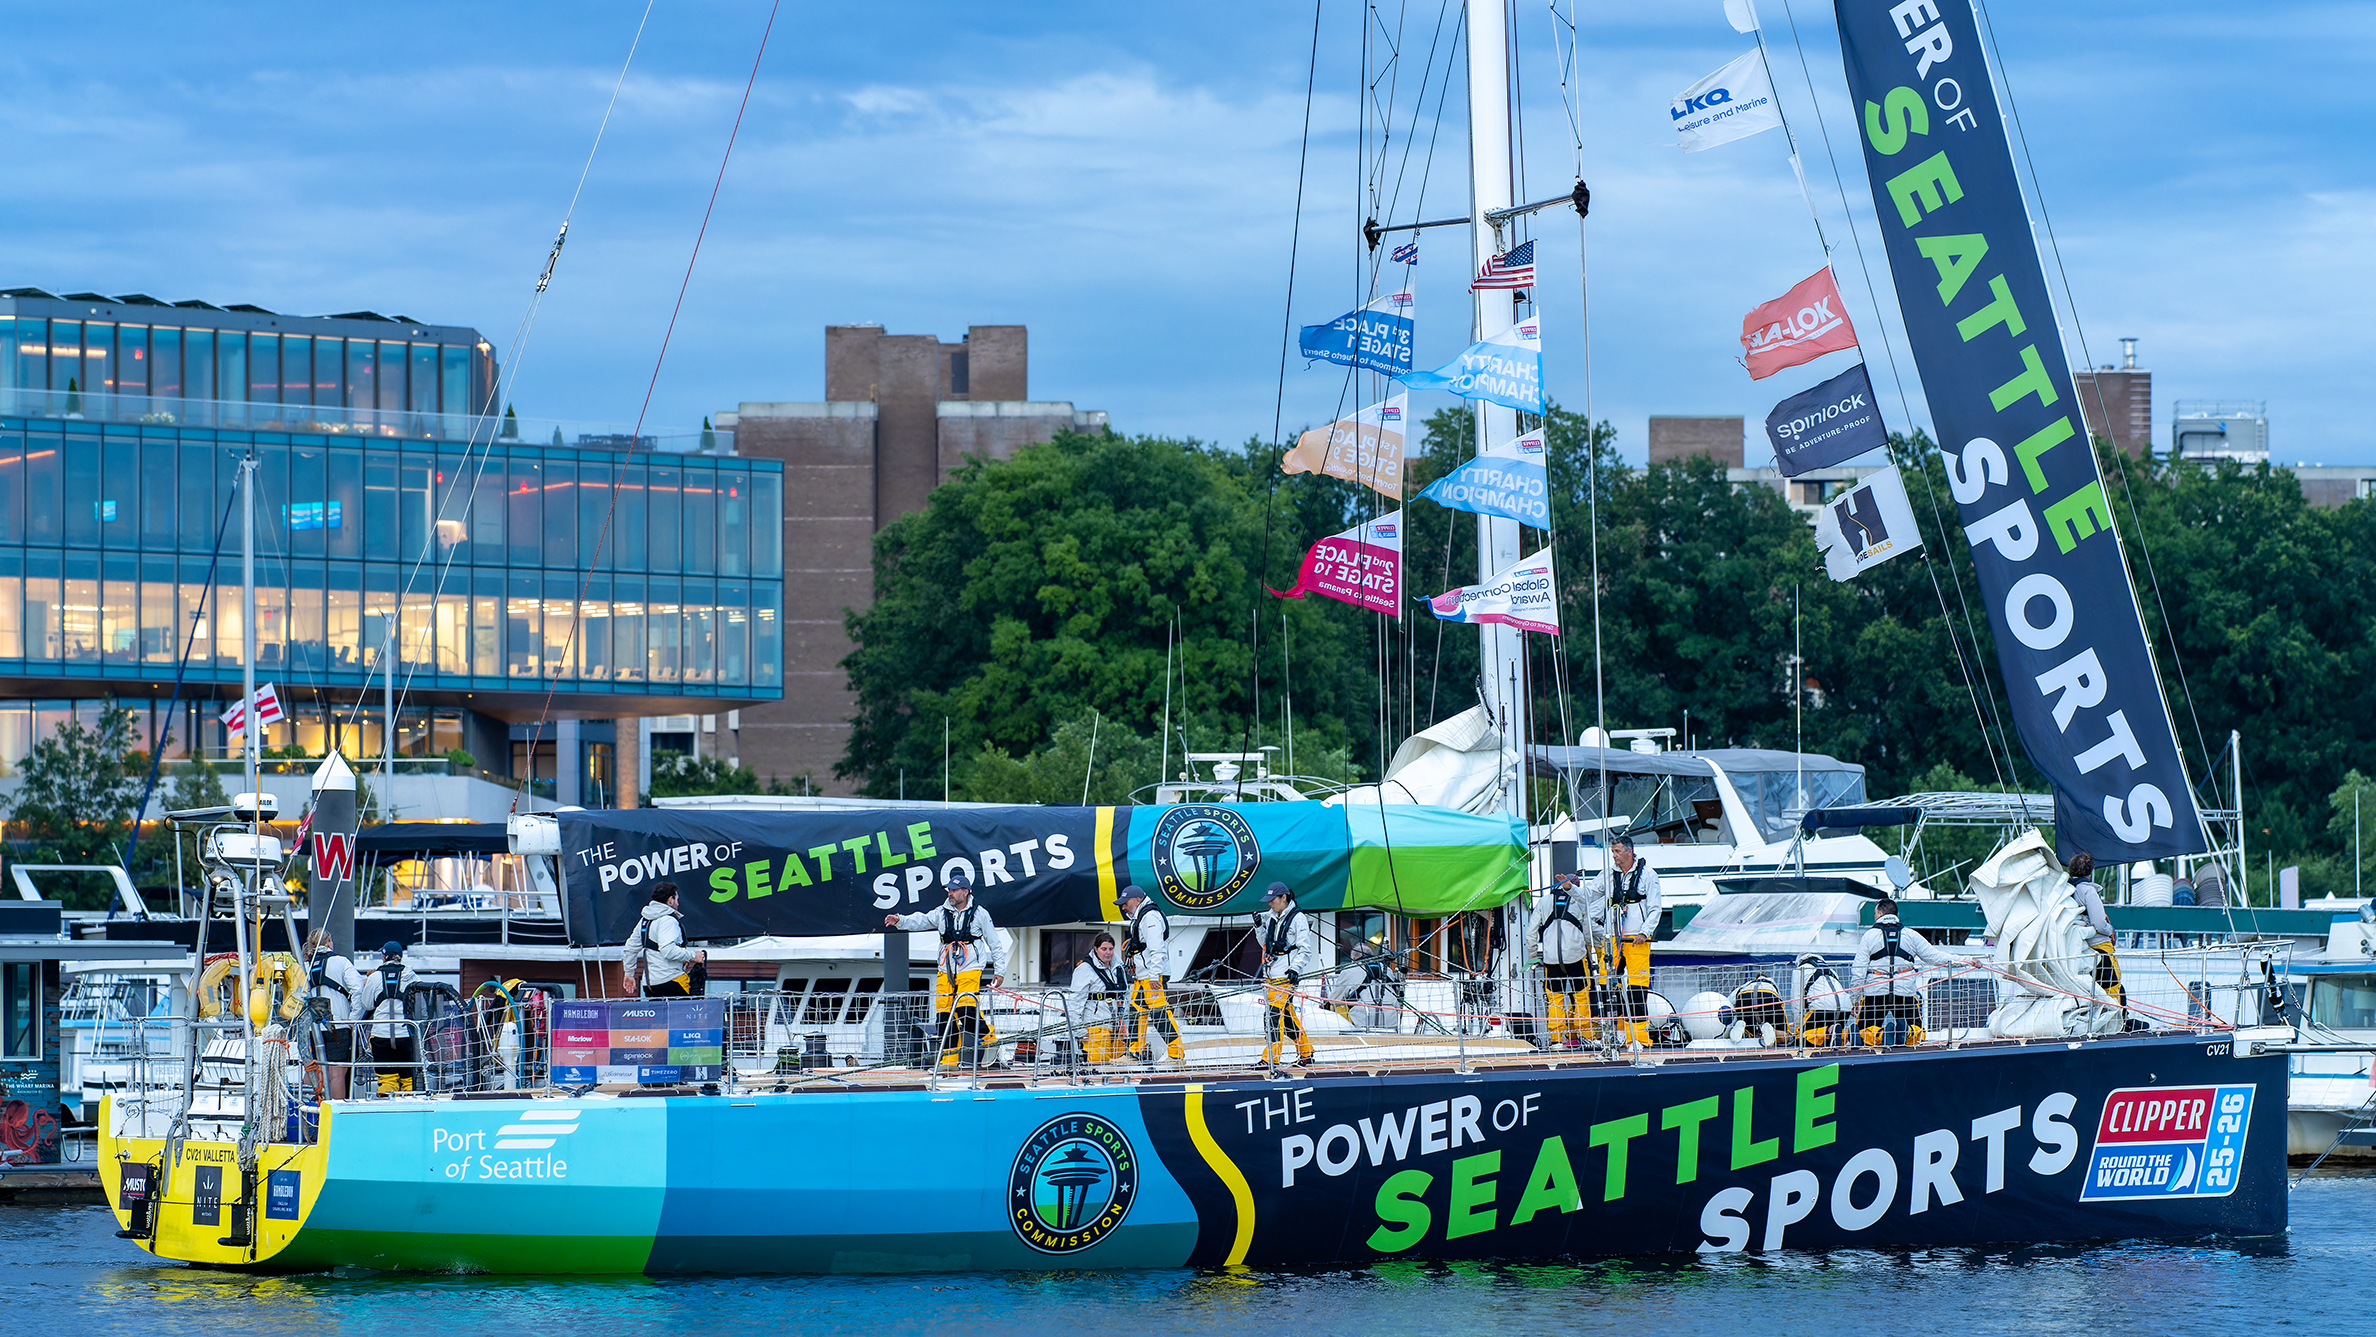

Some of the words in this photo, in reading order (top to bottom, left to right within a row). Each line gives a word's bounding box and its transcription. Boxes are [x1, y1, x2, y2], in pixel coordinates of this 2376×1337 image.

[1670, 88, 1733, 121] LKQ
[1677, 116, 1710, 132] Leisure
[1712, 107, 1734, 121] and
[1735, 96, 1768, 114] Marine
[1934, 78, 1978, 132] OF
[1865, 86, 2112, 556] SEATTLE
[1776, 393, 1867, 441] spinlock
[1785, 447, 1797, 455] BE
[1799, 415, 1871, 450] ADVENTURE-PROOF
[1941, 437, 2173, 844] SPORTS
[1158, 807, 1199, 847] SEATTLE
[1203, 808, 1250, 843] SPORTS
[313, 832, 356, 882] W
[576, 841, 617, 867] THE
[598, 842, 712, 893] POWER
[714, 841, 743, 862] OF
[708, 821, 937, 904] SEATTLE
[872, 833, 1075, 910] SPORTS
[1163, 869, 1250, 905] COMMISSION
[563, 1009, 599, 1019] HAMBLEDON
[622, 1010, 656, 1018] MUSTO
[623, 1035, 652, 1043] STA-LOK
[623, 1053, 653, 1061] spinlock
[2206, 1043, 2230, 1056] CV21
[2109, 1099, 2206, 1133] CLIPPER
[185, 1148, 202, 1161] CV21
[202, 1149, 235, 1163] VALLETTA
[433, 1128, 486, 1153] Port
[1020, 1121, 1078, 1174] SEATTLE
[1084, 1122, 1130, 1171] SPORTS
[1235, 1087, 1316, 1133] THE
[1281, 1094, 1485, 1188] POWER
[1492, 1092, 1541, 1131] OF
[1366, 1062, 1839, 1253] SEATTLE
[2206, 1093, 2245, 1186] 25-26
[445, 1156, 473, 1181] of
[479, 1152, 567, 1179] Seattle
[1696, 1091, 2079, 1252] SPORTS
[2096, 1166, 2170, 1187] WORLD
[2099, 1155, 2147, 1169] ROUND
[2149, 1154, 2174, 1167] THE
[197, 1196, 219, 1209] NITE
[1017, 1203, 1123, 1248] COMMISSION
